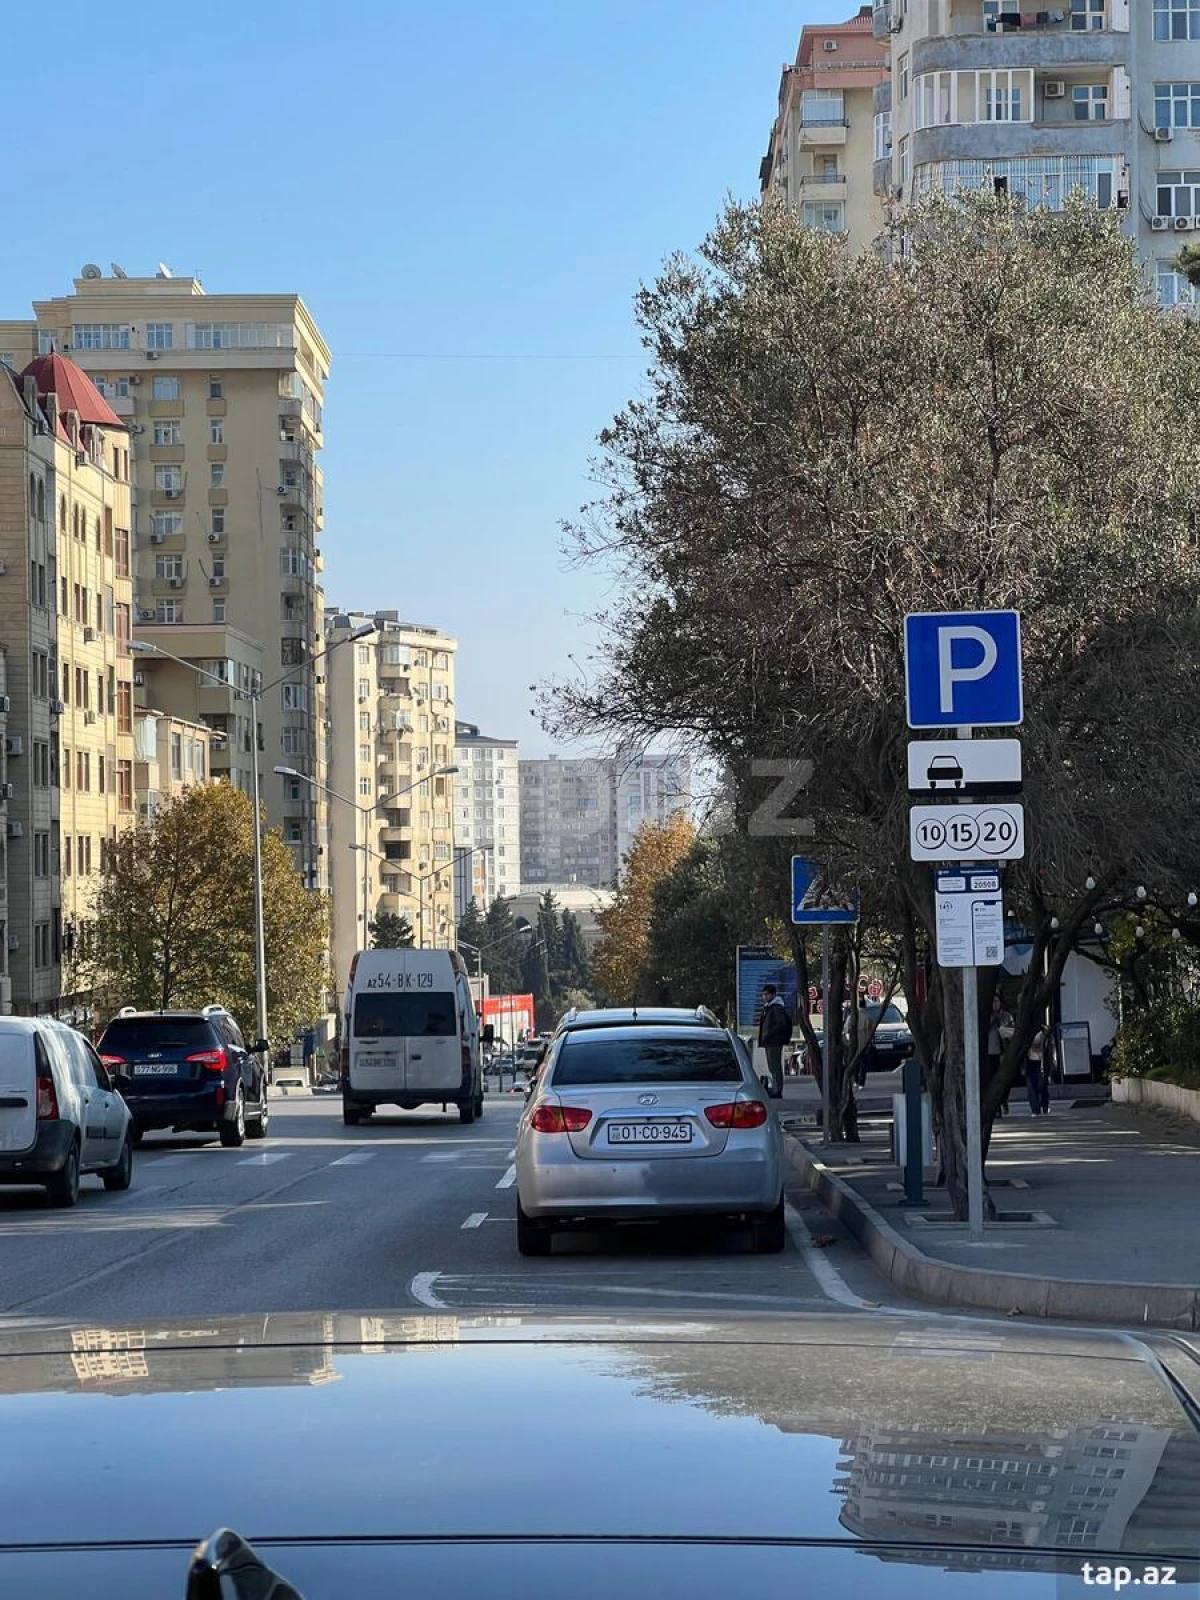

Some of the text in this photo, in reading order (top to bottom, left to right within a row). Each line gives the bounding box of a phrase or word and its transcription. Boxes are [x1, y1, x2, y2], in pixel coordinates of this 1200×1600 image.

[938, 625, 997, 713] P
[921, 820, 1012, 842] 10 15 20
